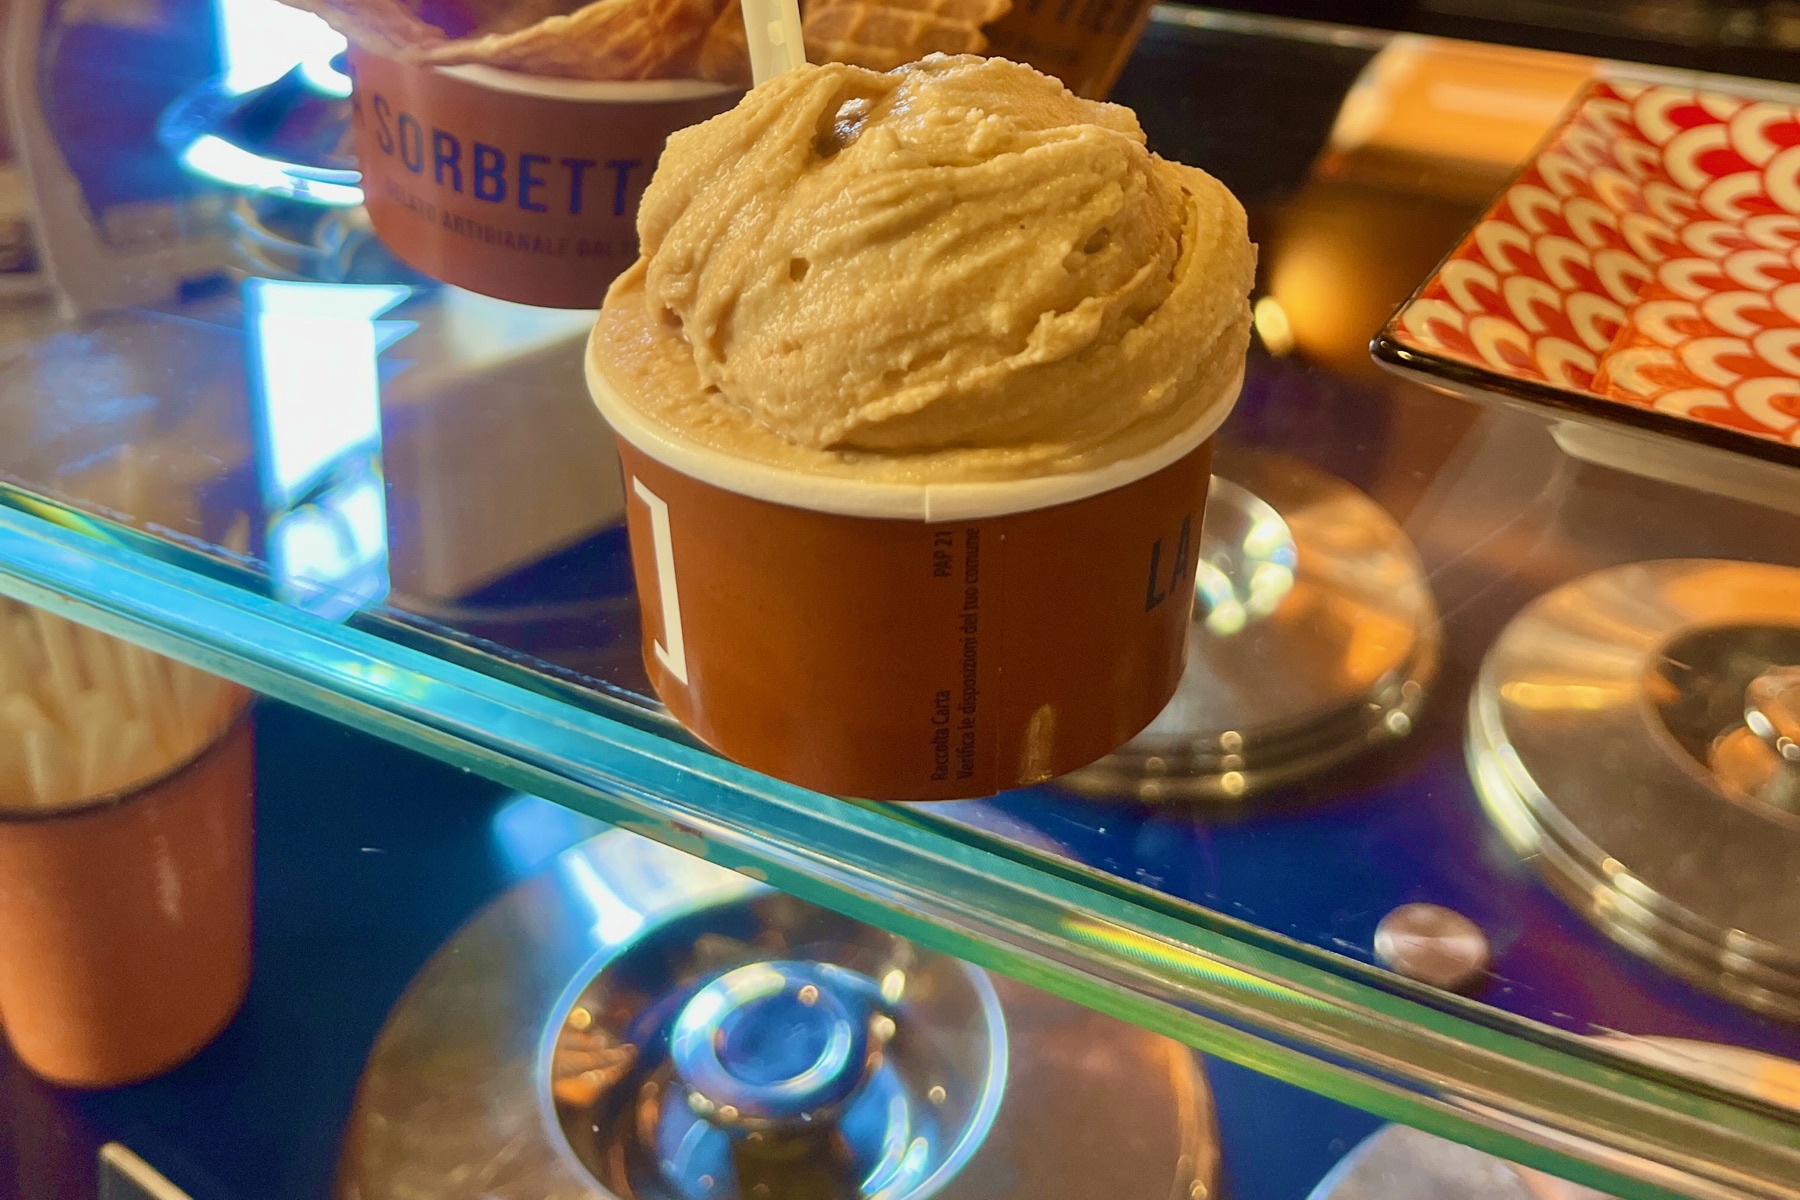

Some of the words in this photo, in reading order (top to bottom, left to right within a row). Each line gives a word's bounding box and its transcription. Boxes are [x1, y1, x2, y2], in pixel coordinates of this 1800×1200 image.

[934, 530, 952, 548] 21
[965, 527, 980, 585] comune
[933, 551, 952, 578] PAP
[1145, 513, 1191, 614] LA
[964, 587, 979, 611] tuo
[960, 612, 978, 635] del
[957, 637, 980, 715] disposizioni
[931, 689, 951, 726] Carta
[957, 717, 976, 730] le
[930, 727, 951, 782] Raccolta
[957, 732, 976, 780] Verifica
